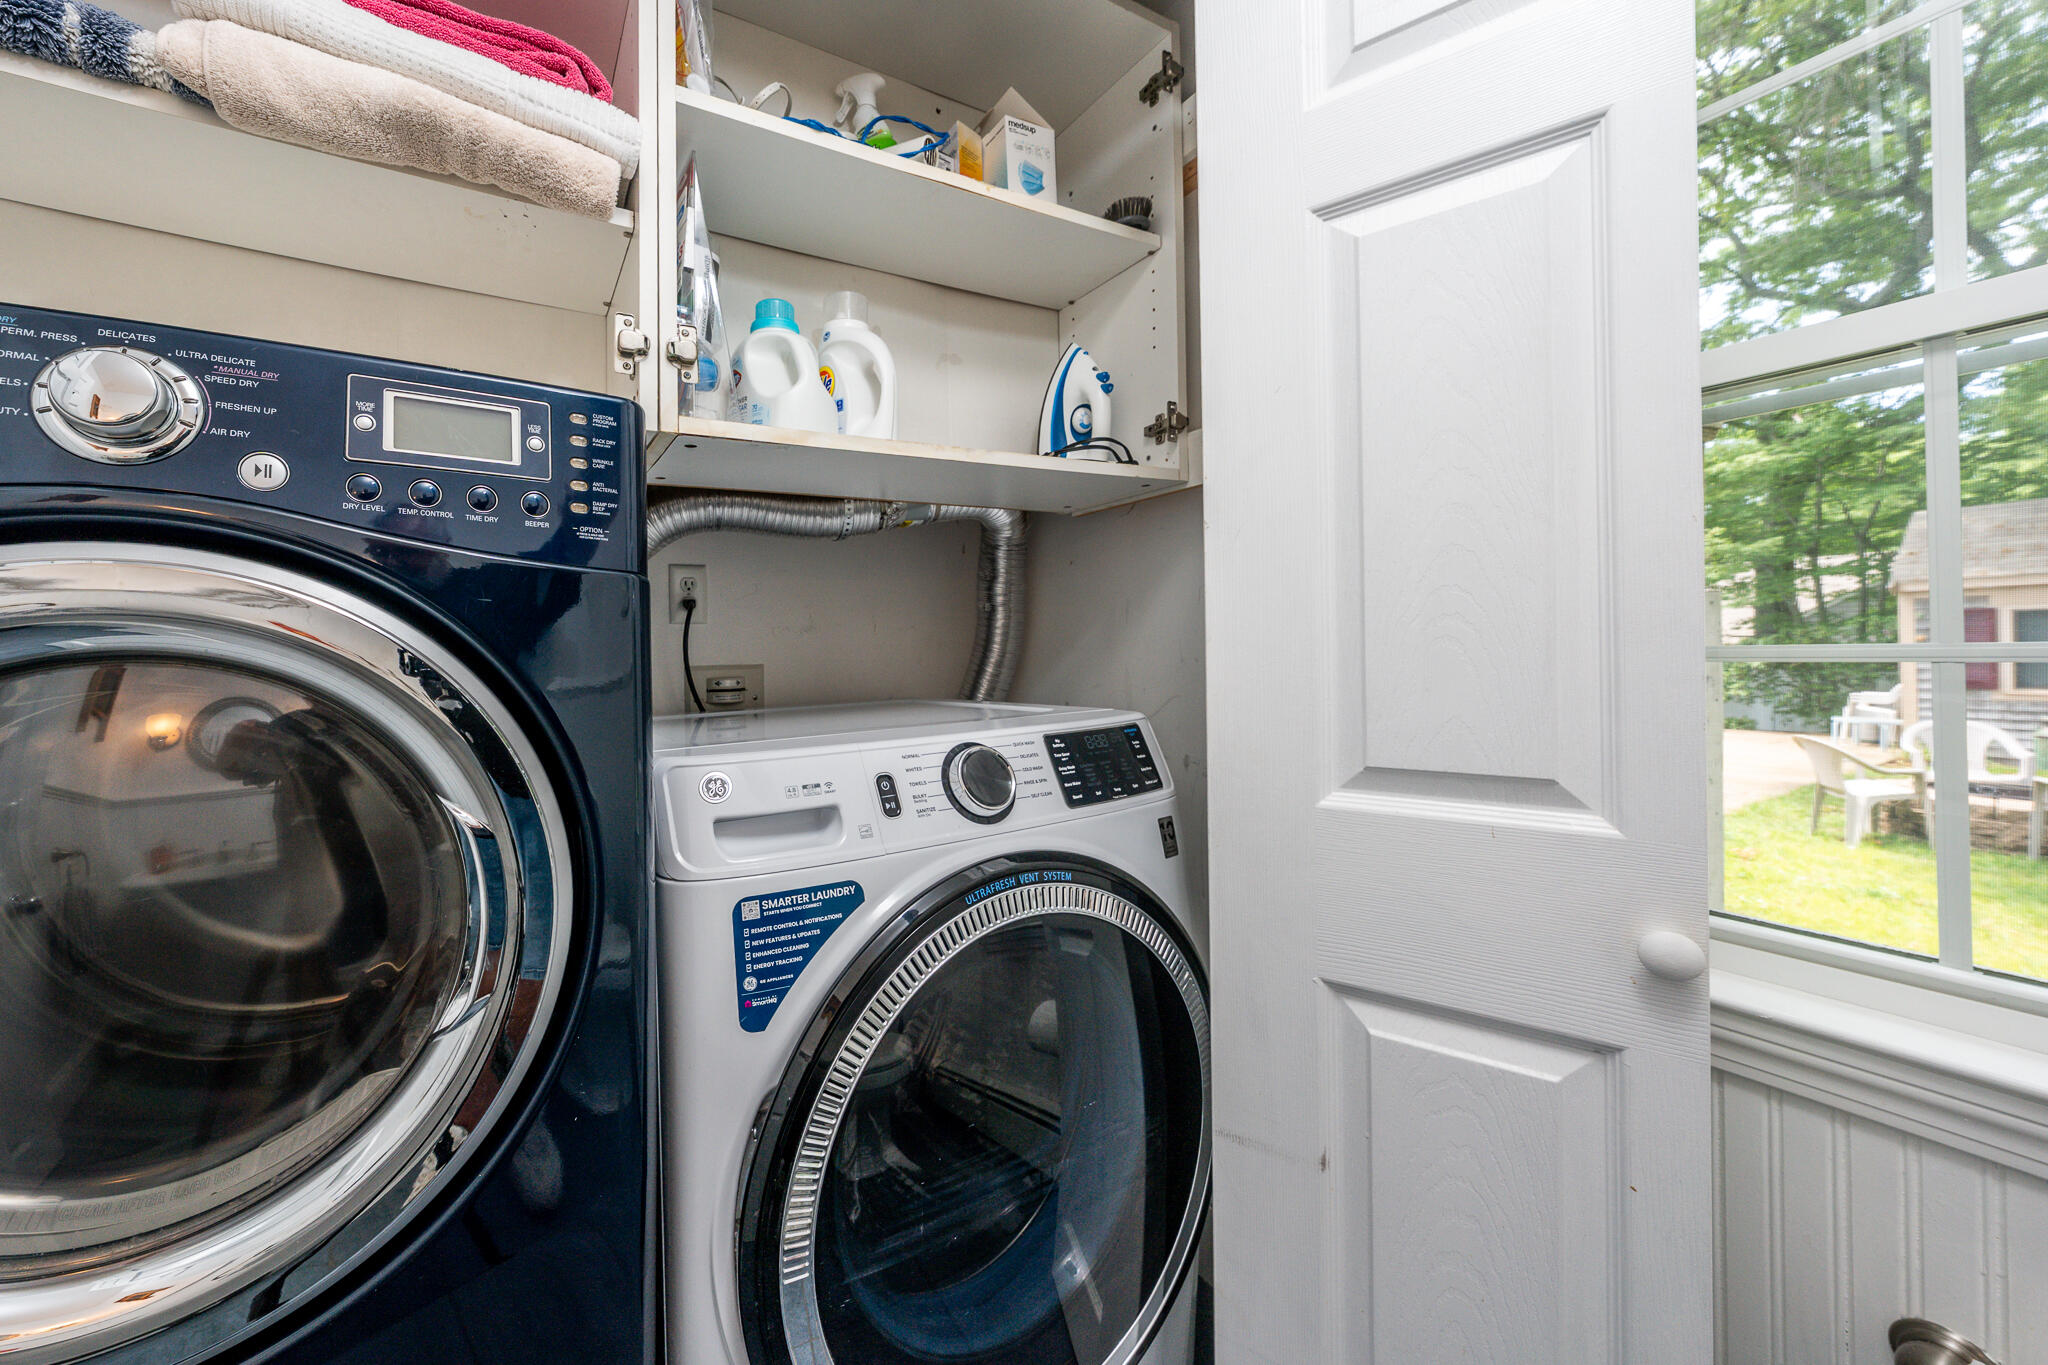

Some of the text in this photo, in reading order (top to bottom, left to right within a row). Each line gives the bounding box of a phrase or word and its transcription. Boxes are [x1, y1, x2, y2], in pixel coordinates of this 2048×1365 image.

[1008, 120, 1036, 134] medsup
[40, 331, 78, 343] PRESS
[97, 328, 156, 343] DELICATES
[175, 349, 256, 367] ULTRA DELICATE
[204, 374, 260, 389] SPEED DRY
[261, 371, 280, 380] DRY
[215, 401, 278, 416] FRESHEN UP
[355, 400, 376, 410] MORE
[358, 405, 374, 413] TIME
[592, 419, 617, 427] PROGRAM
[209, 427, 251, 439] AIR DRY
[592, 458, 614, 466] WRINKLE
[592, 487, 619, 495] BACTERIAL
[342, 502, 386, 513] DRY LEVEL
[397, 507, 455, 519] TEMP. CONTROL
[465, 514, 499, 524] TIME DRY
[525, 520, 550, 529] BEEPER
[579, 526, 603, 534] OPTION
[915, 806, 937, 814] SANITIZE
[965, 871, 1072, 905] ULTRAFRESH VENT SYSTEM
[761, 884, 856, 910] SMARTER LAUNDRY
[763, 909, 780, 917] STARTS
[780, 907, 793, 915] WHEN
[802, 902, 823, 911] CONNECT
[750, 925, 773, 935] REMOTE
[773, 922, 799, 931] CONTROL
[804, 913, 843, 925] NOTIFICATIONS
[751, 938, 765, 947] NEW
[765, 935, 792, 945] FEATURES
[797, 929, 821, 939] UPDATES
[752, 942, 810, 959] ENHANCED CLEANING
[753, 955, 803, 971] ENERGY TRACKING
[766, 974, 794, 983] APPLIANCES
[751, 997, 777, 1007] SmartHQ
